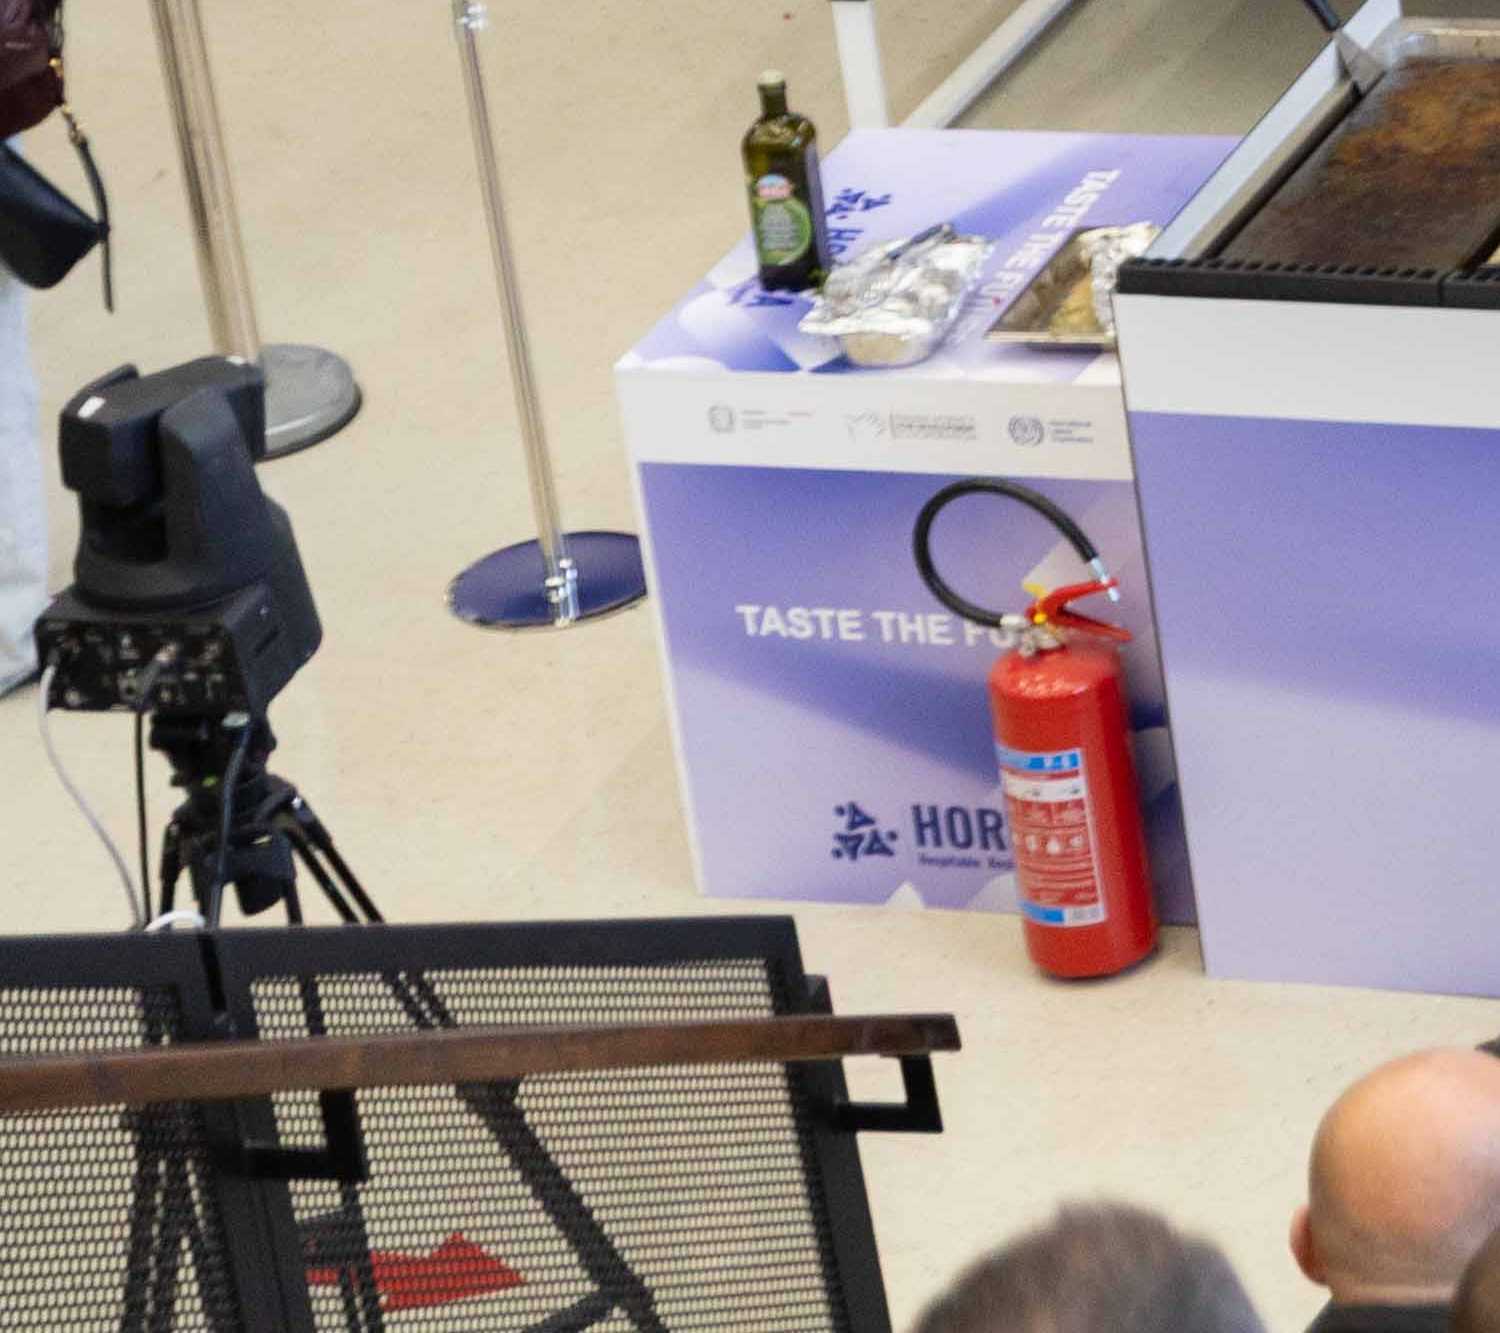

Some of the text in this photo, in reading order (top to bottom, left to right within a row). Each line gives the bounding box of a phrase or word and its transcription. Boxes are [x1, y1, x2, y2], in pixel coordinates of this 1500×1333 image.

[735, 604, 865, 642] TASTE
[872, 610, 955, 646] THE
[911, 803, 1008, 851] HOR
